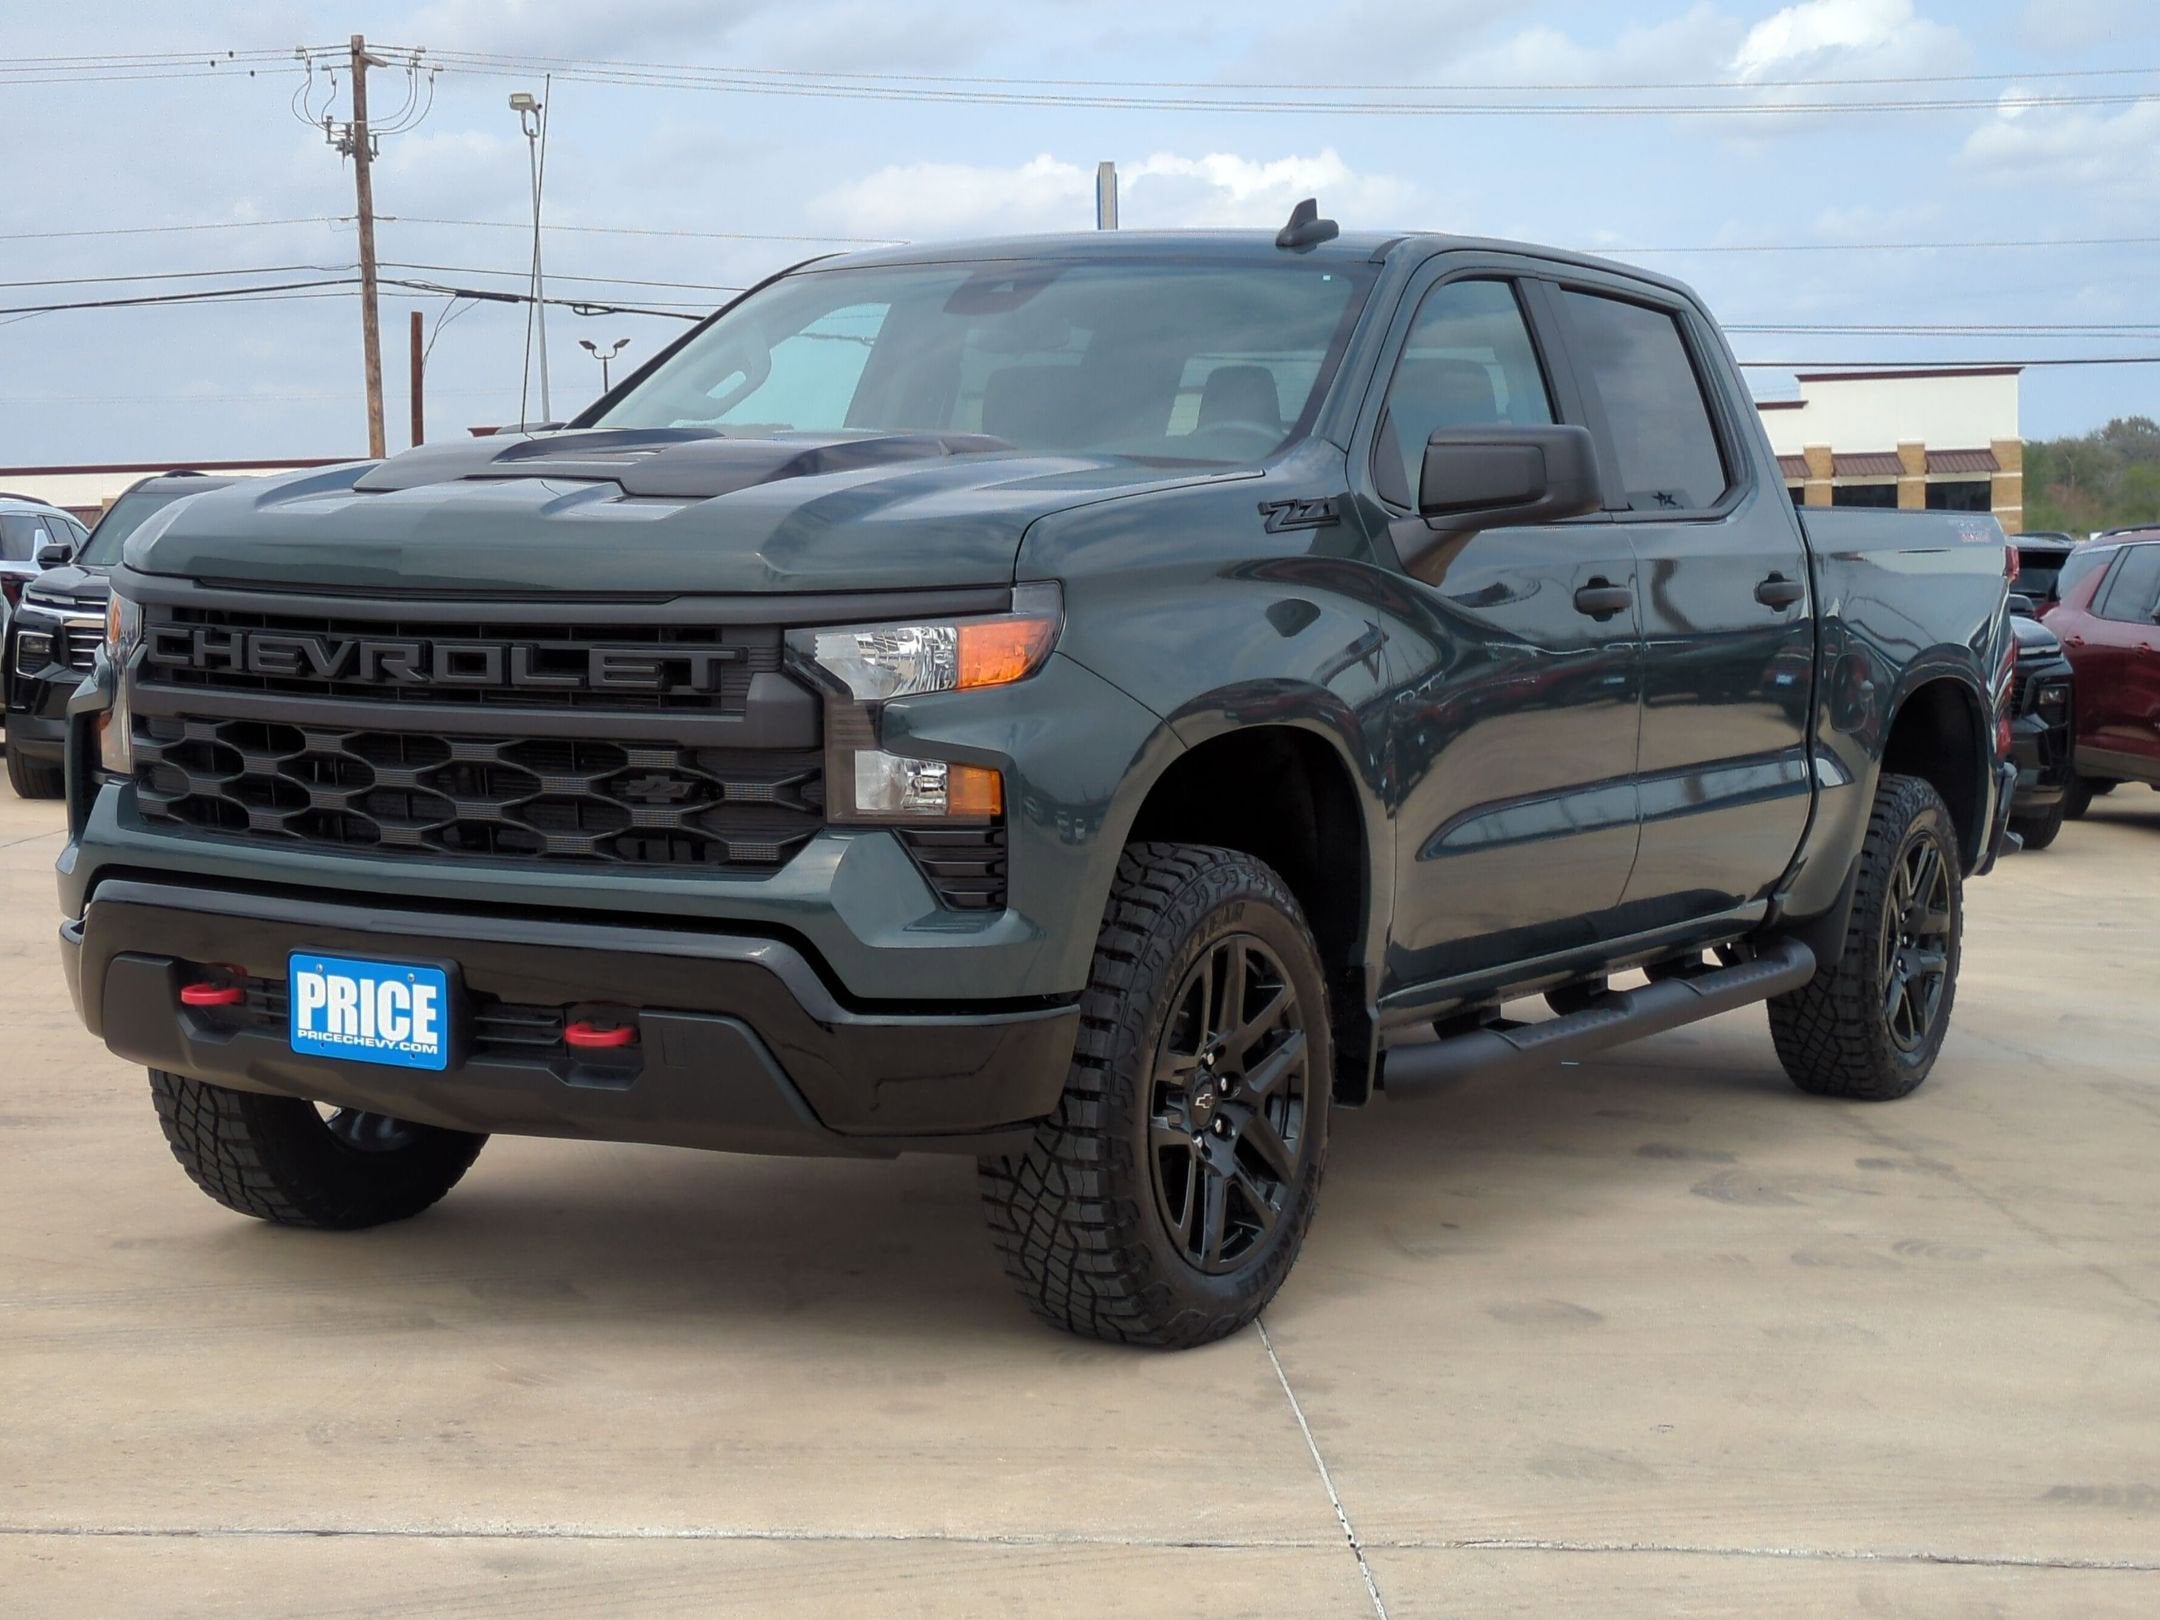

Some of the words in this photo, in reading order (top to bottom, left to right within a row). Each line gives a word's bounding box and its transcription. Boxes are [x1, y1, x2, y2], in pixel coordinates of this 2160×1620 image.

[1258, 497, 1340, 533] Z71
[147, 625, 747, 691] CHEVROLET
[297, 971, 438, 1044] PRICE
[297, 1029, 438, 1054] PRICECHEVY.COM
